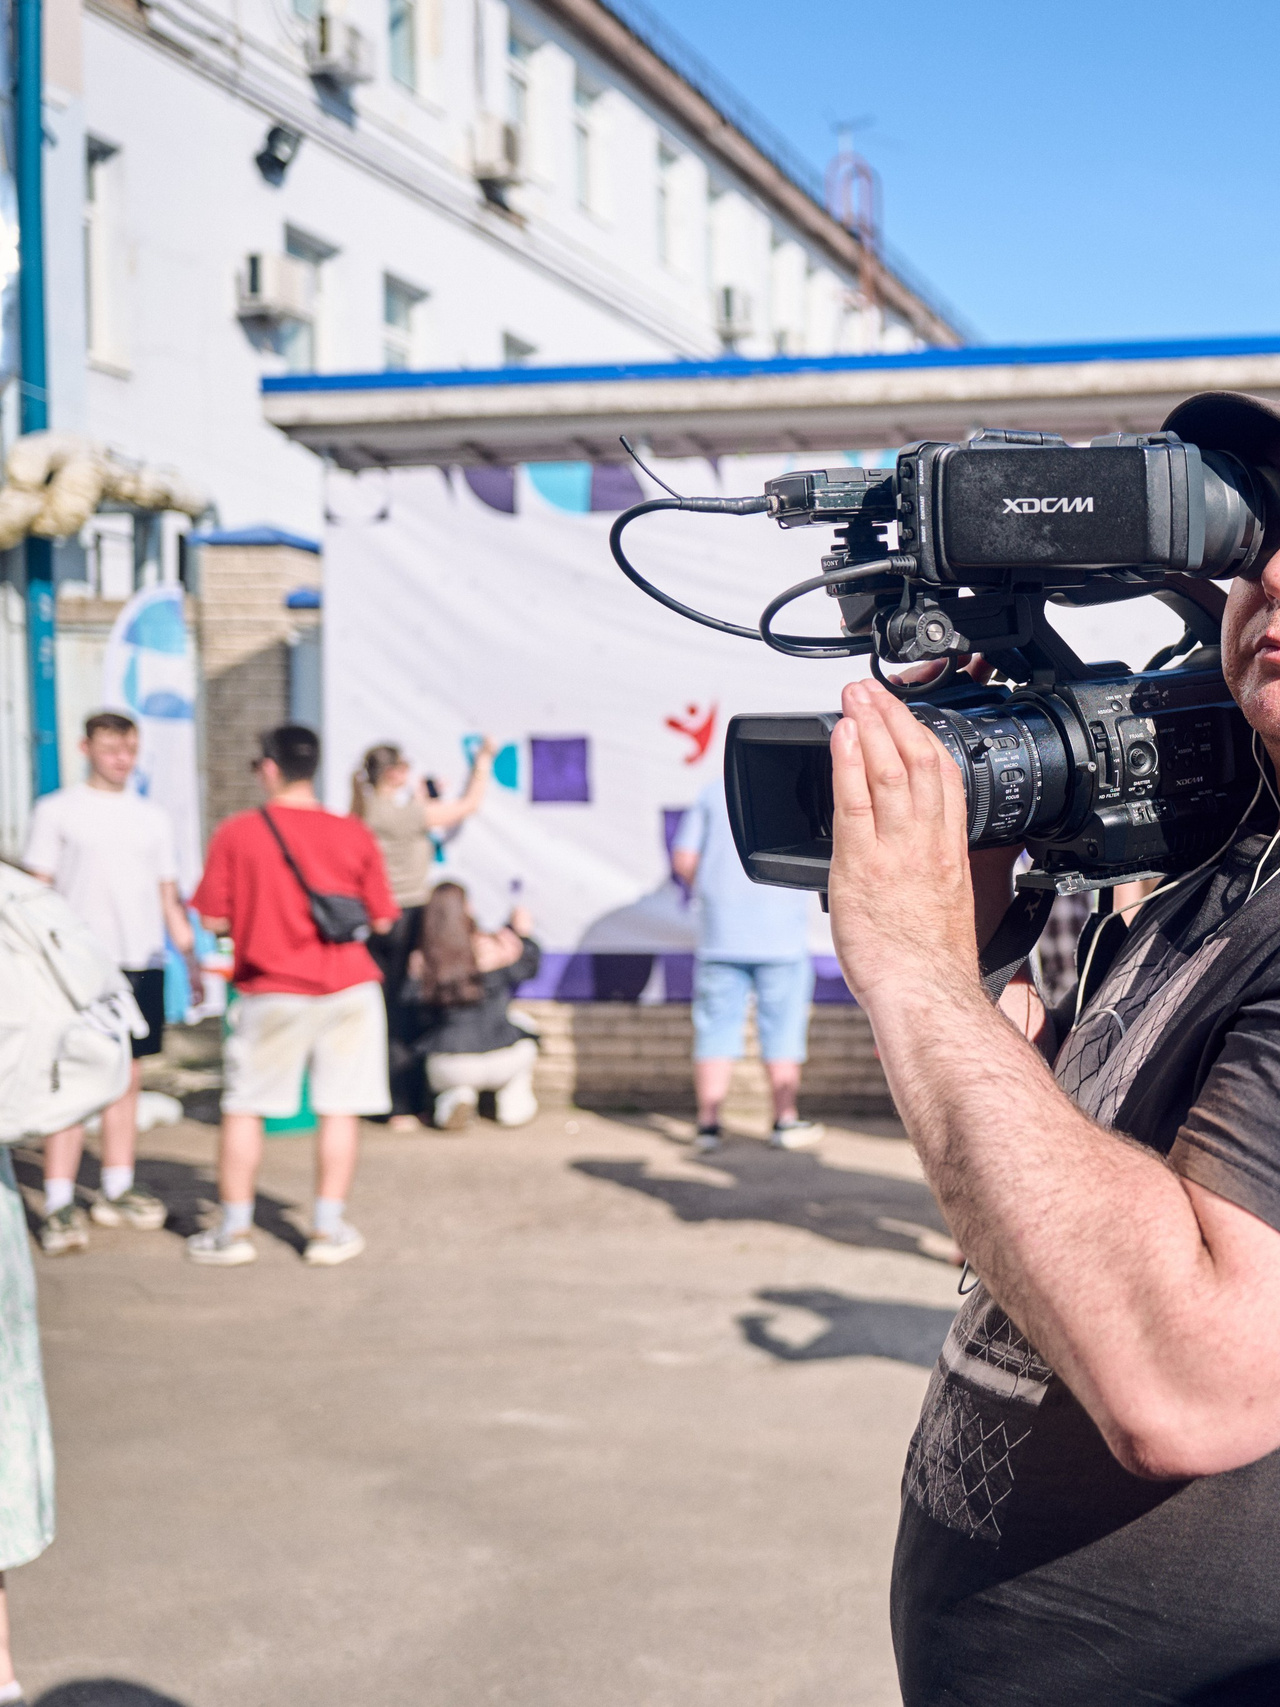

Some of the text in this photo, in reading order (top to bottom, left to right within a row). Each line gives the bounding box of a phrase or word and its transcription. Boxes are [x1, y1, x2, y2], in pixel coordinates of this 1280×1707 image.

[1002, 496, 1094, 514] XDCAM
[823, 559, 839, 568] SONY
[1175, 775, 1204, 787] XDCAM
